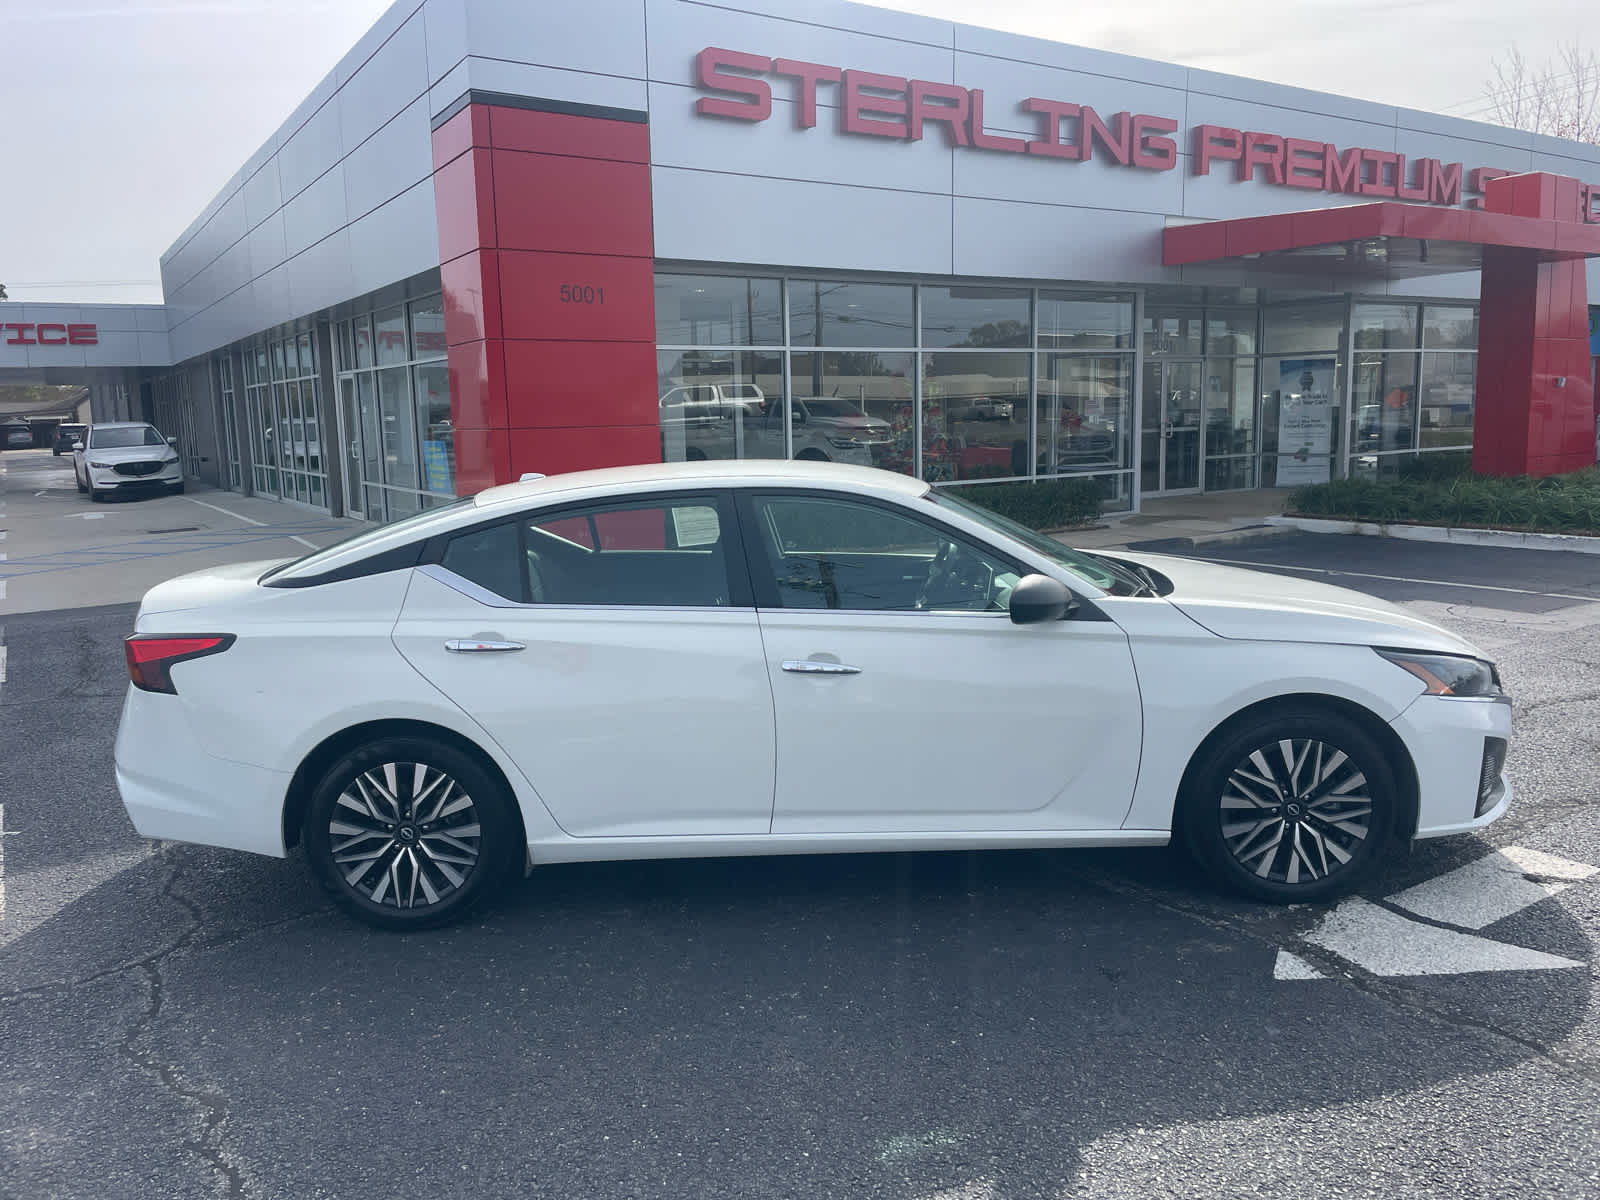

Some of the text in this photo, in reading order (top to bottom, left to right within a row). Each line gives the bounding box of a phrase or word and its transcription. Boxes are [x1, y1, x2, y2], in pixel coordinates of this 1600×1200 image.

[696, 46, 1178, 171] STERLING
[1193, 124, 1463, 205] PREMIUM
[560, 284, 604, 304] 5001
[0, 323, 98, 344] ICE
